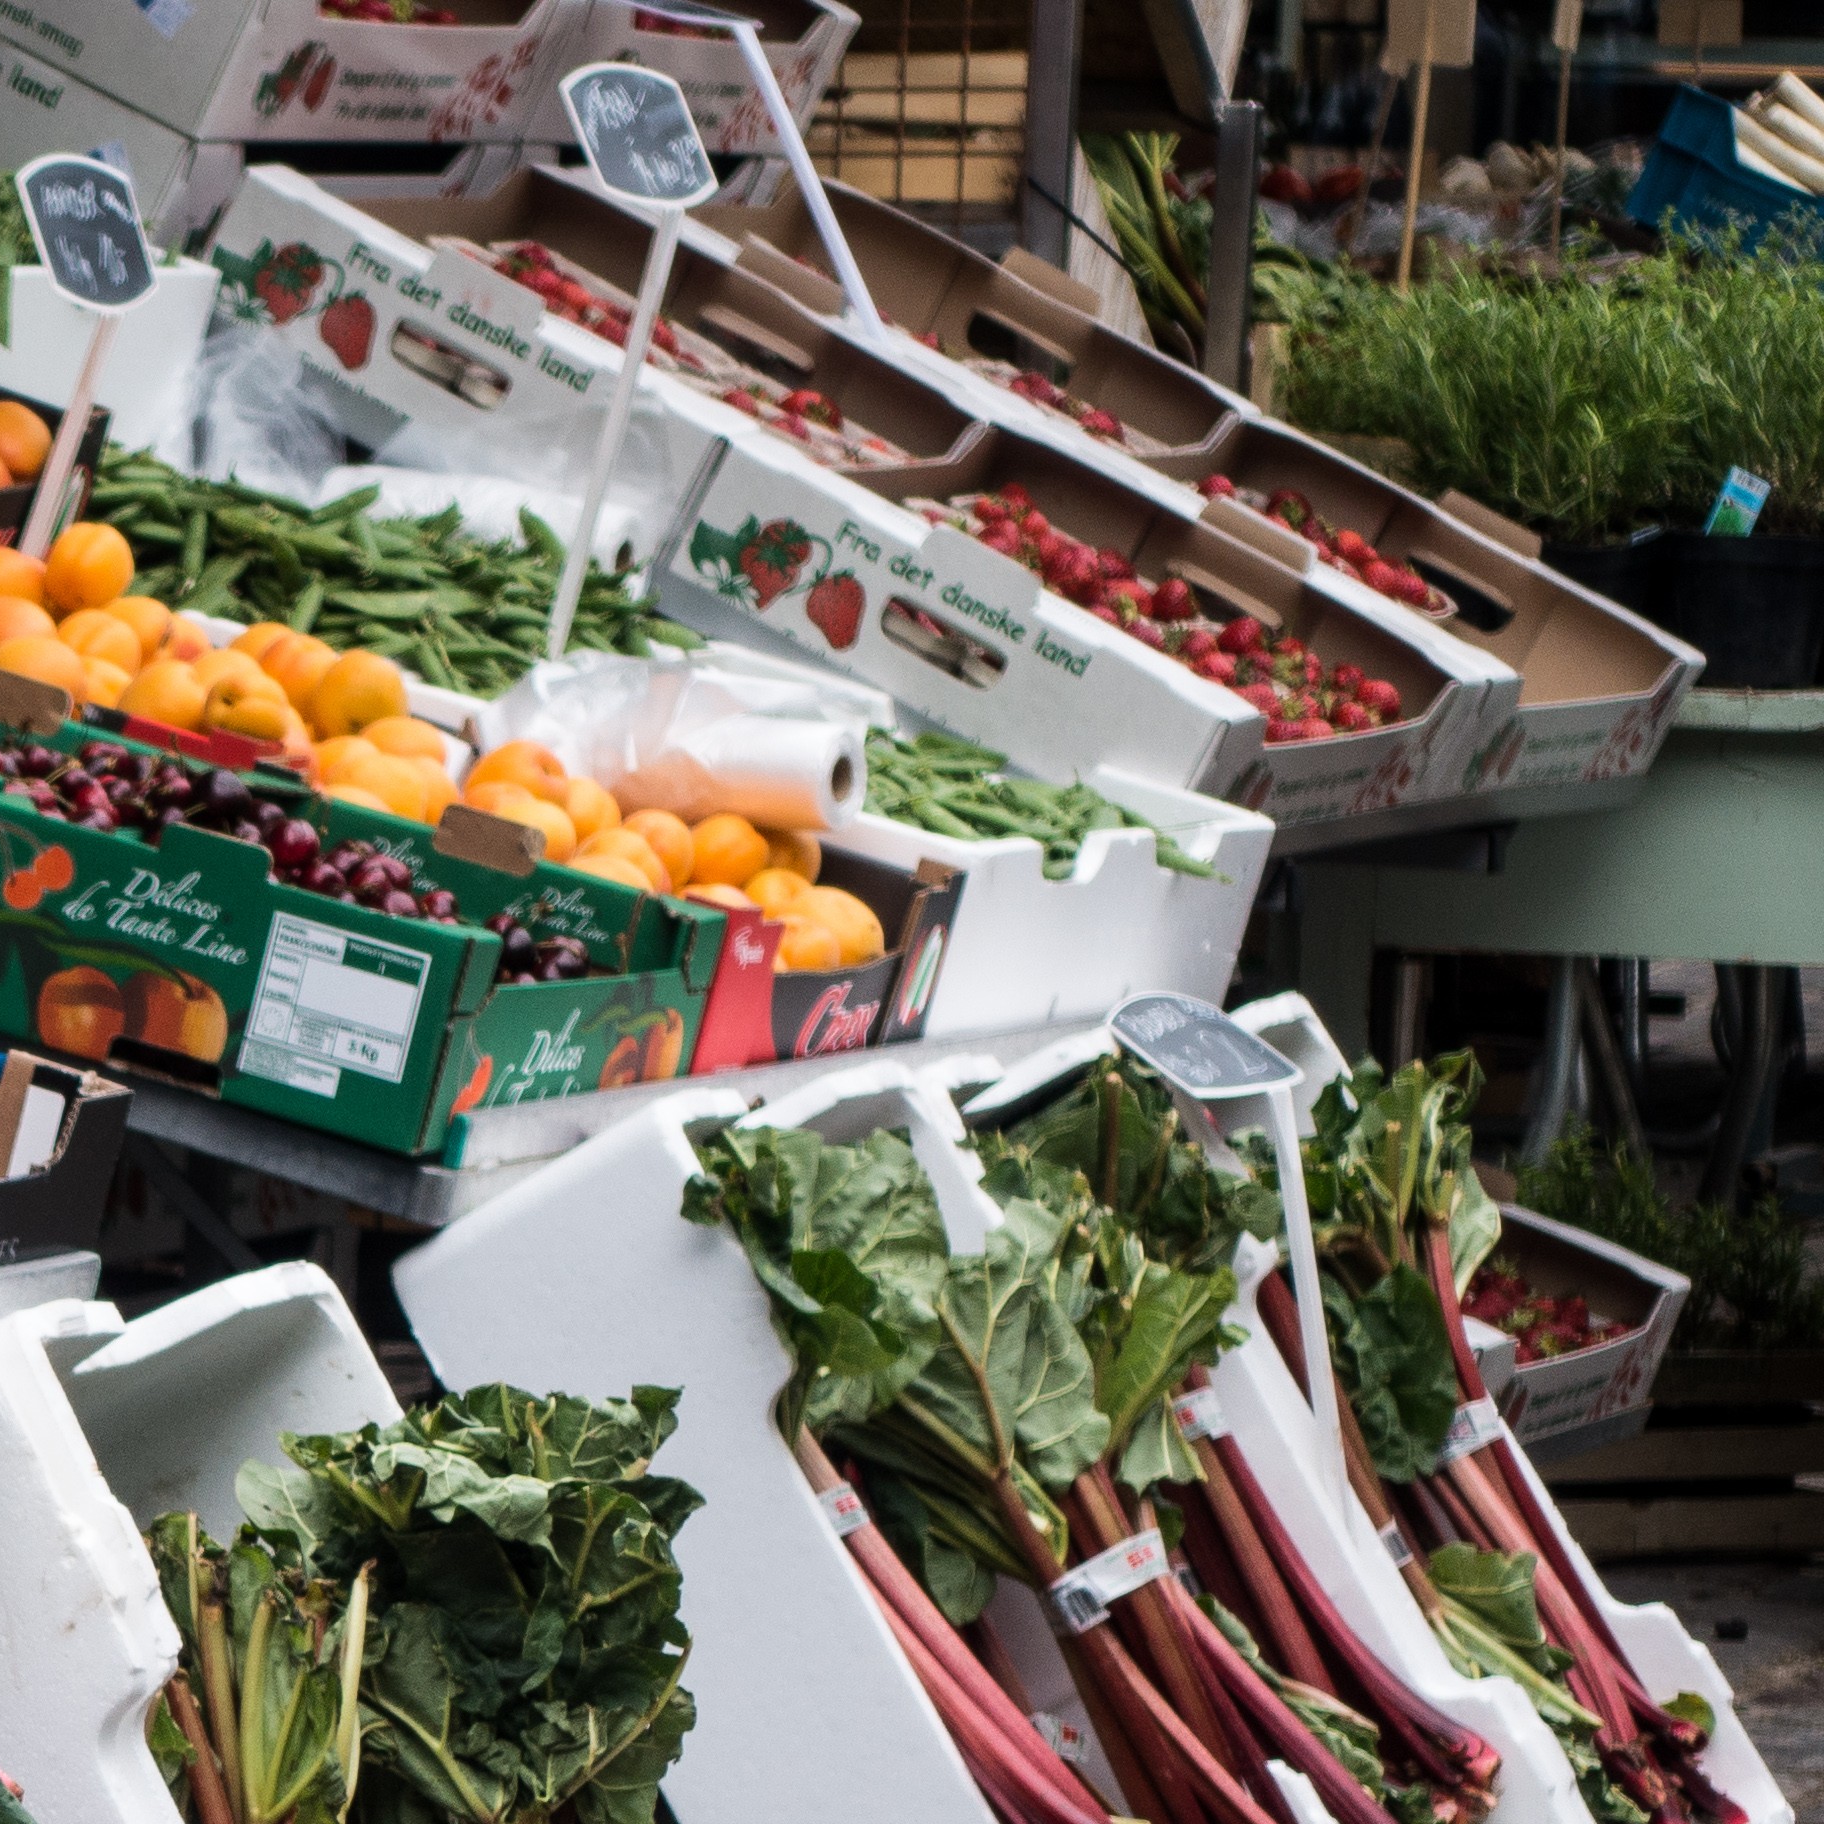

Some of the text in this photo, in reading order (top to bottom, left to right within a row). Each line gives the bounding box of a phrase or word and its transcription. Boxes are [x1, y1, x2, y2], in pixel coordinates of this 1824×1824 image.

[345, 242, 594, 393] Fra det danske land
[835, 518, 1093, 679] Fra det danske land
